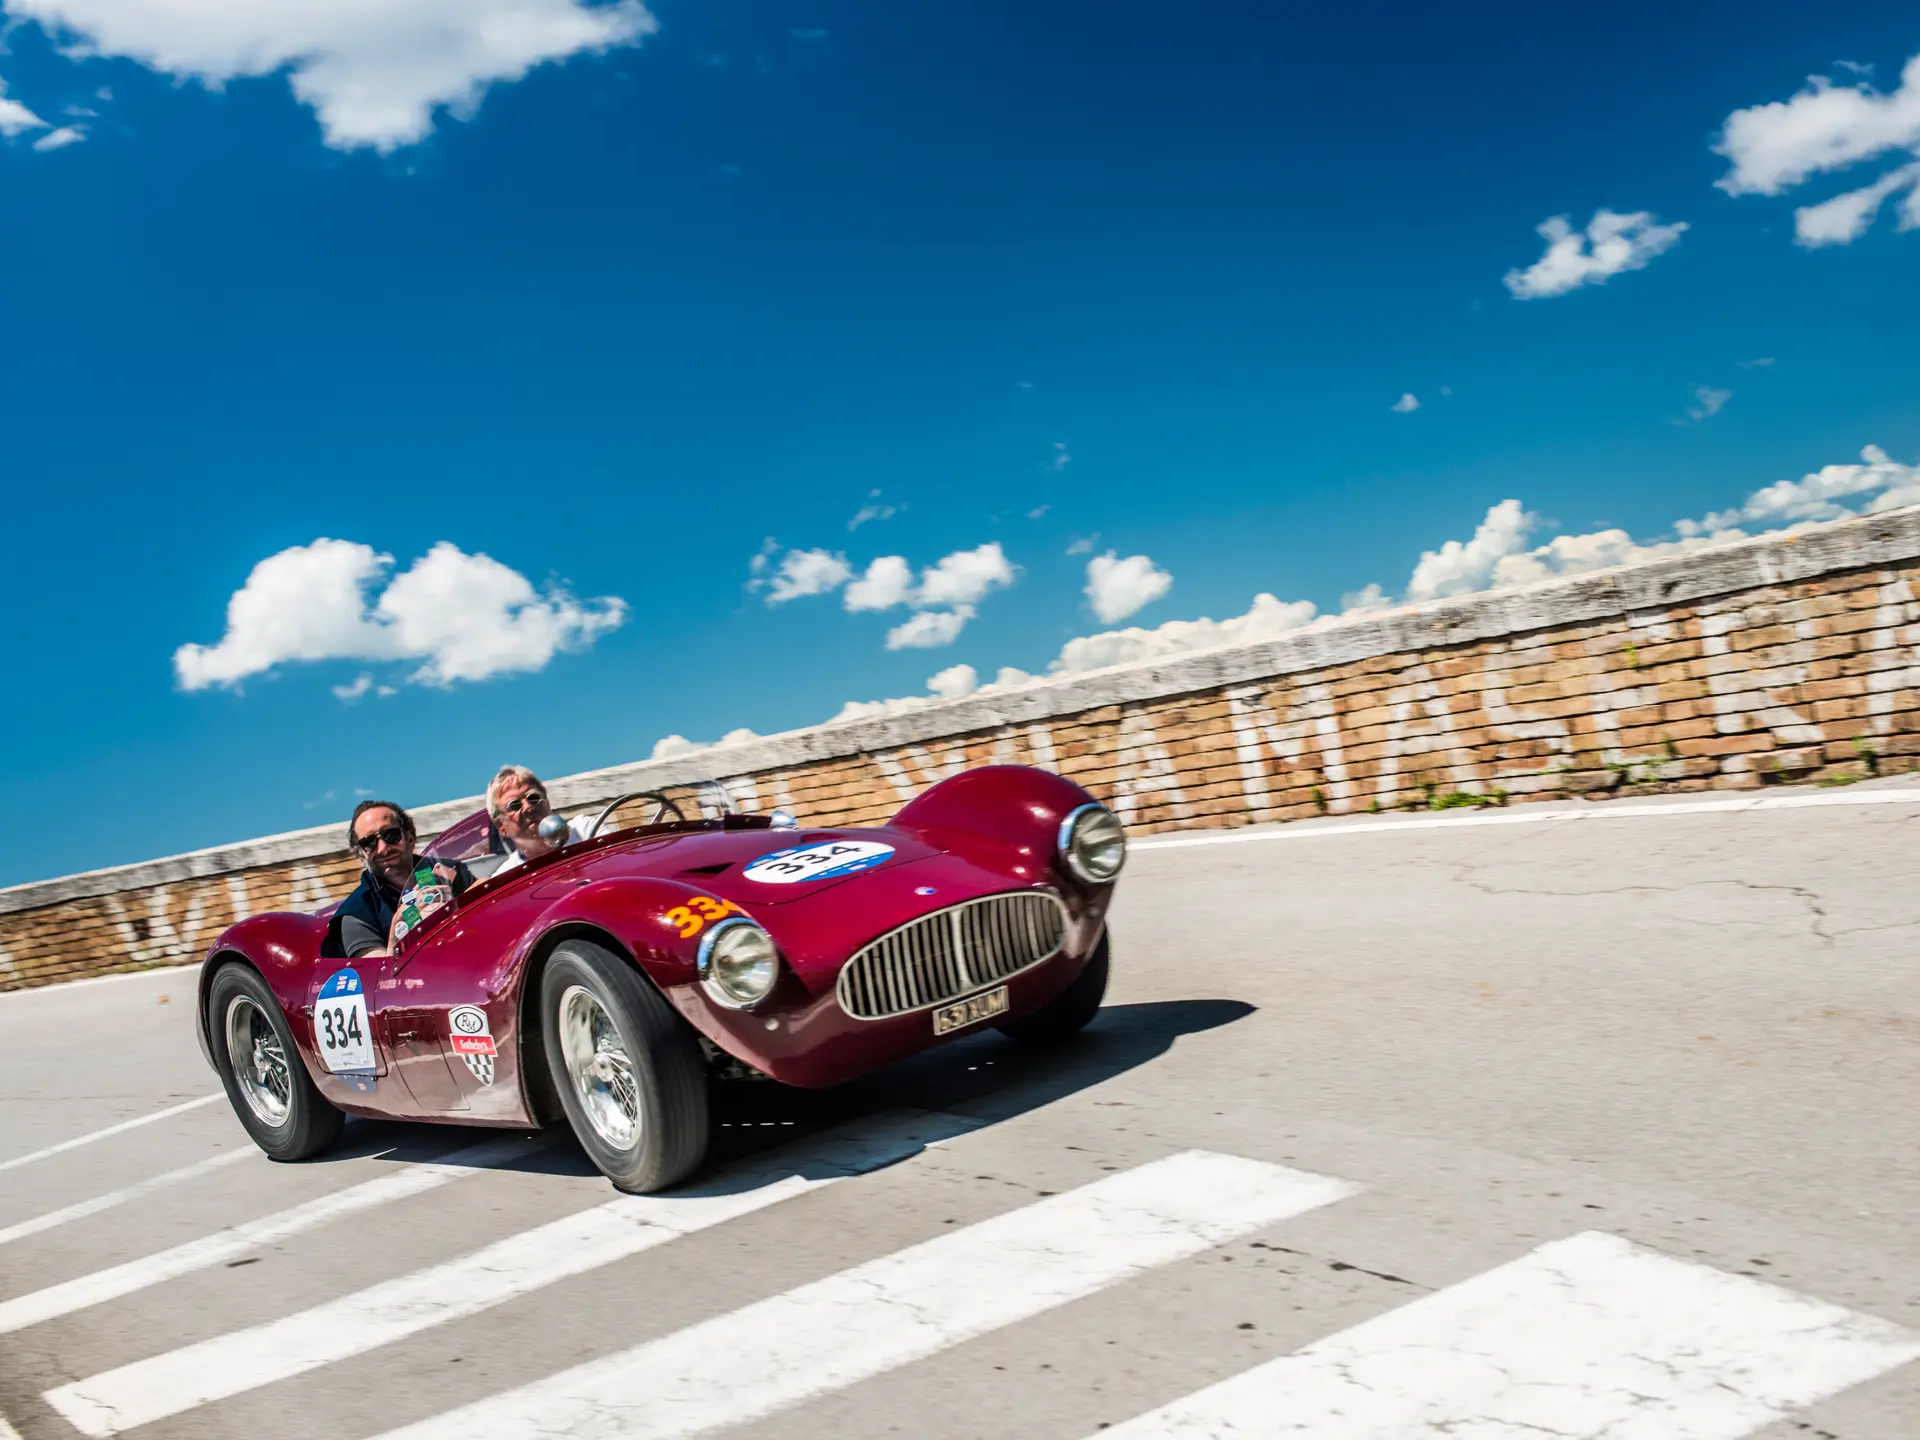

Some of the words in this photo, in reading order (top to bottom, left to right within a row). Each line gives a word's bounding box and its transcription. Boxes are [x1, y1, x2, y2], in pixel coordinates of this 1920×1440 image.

[766, 845, 861, 875] 334
[321, 1004, 363, 1050] 334
[461, 1014, 477, 1032] RM
